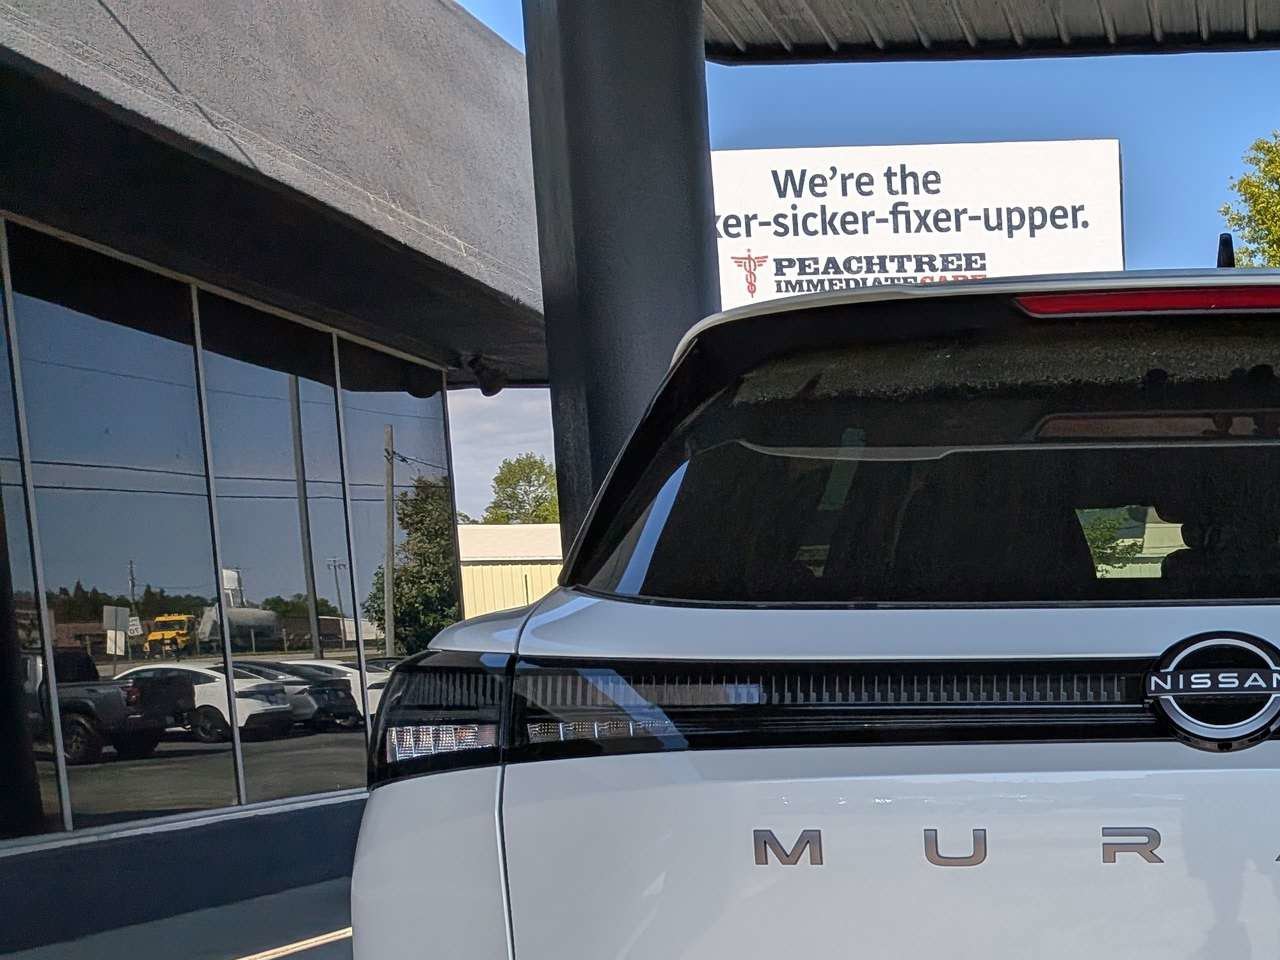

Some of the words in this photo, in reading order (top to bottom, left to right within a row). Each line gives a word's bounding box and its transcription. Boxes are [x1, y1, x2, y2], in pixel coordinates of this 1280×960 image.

[771, 165, 874, 198] We're
[884, 163, 942, 195] the
[773, 252, 987, 277] PEACHTREE
